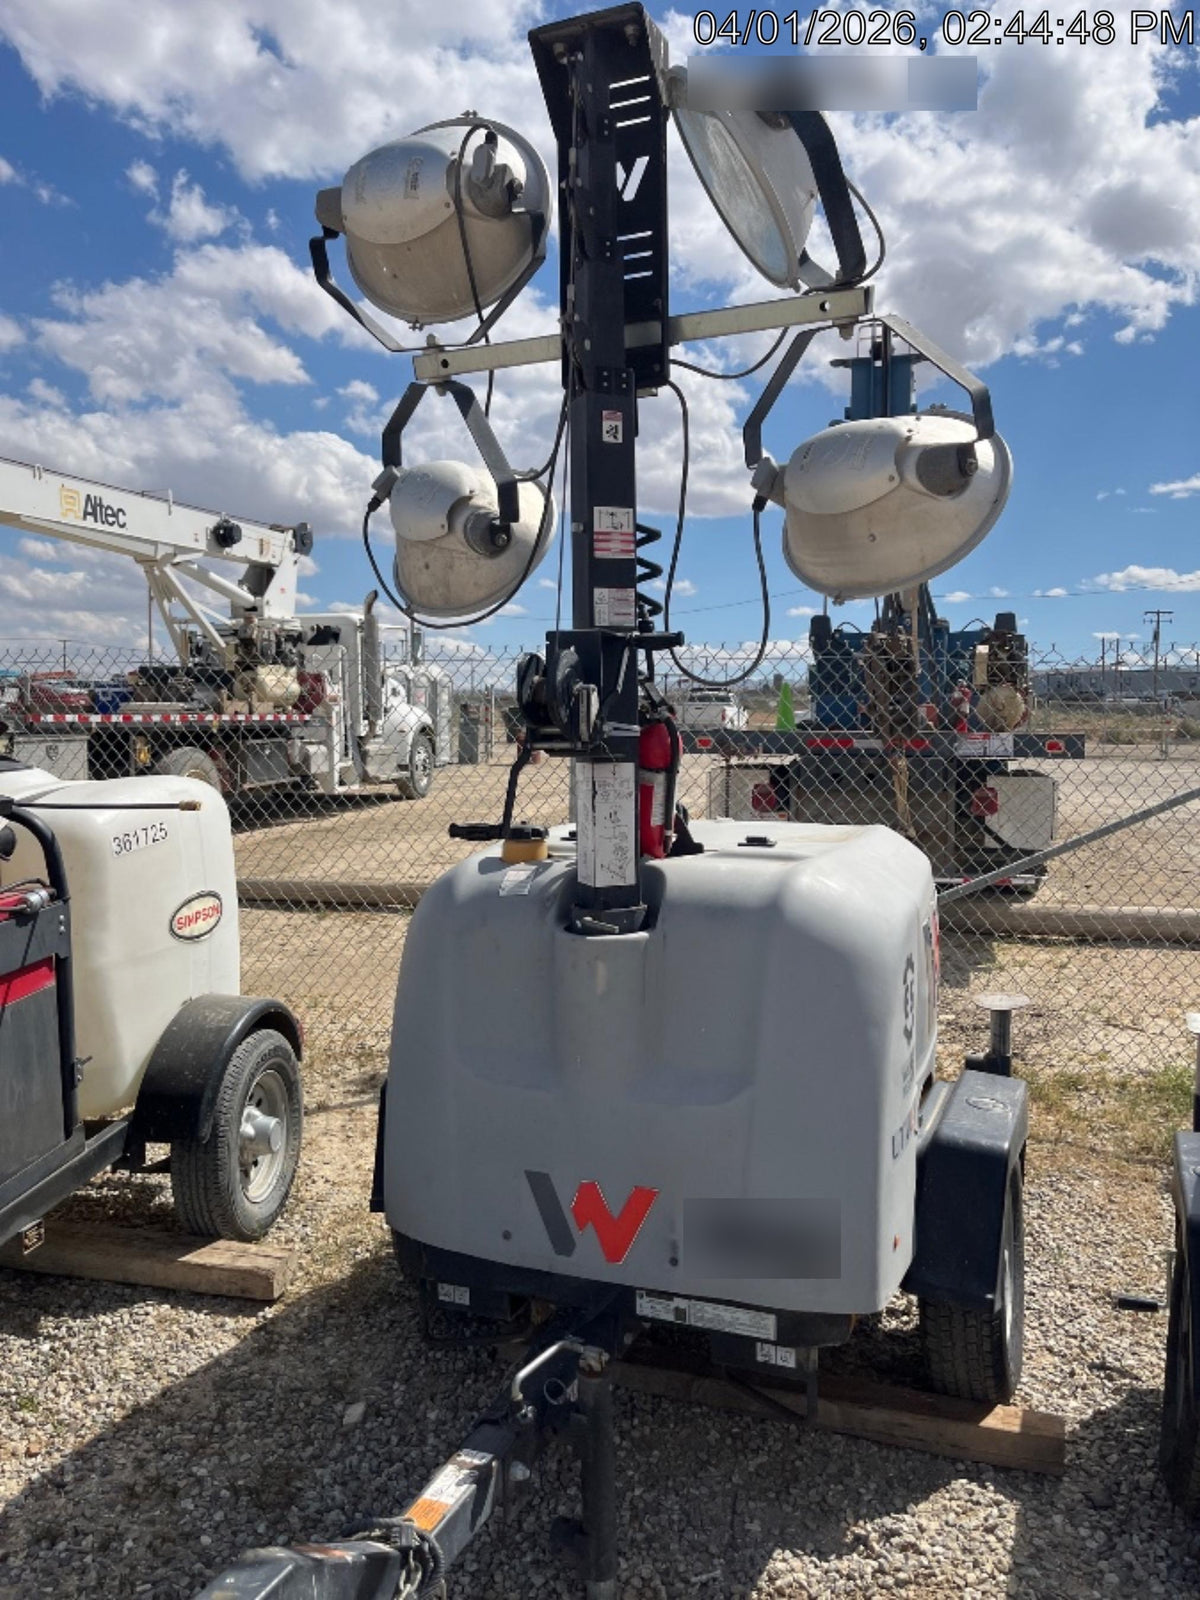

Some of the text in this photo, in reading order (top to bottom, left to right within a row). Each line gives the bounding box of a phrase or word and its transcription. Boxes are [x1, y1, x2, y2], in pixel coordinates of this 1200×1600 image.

[83, 493, 127, 529] Altec
[112, 822, 168, 856] 361725
[176, 903, 220, 931] SIMPSON
